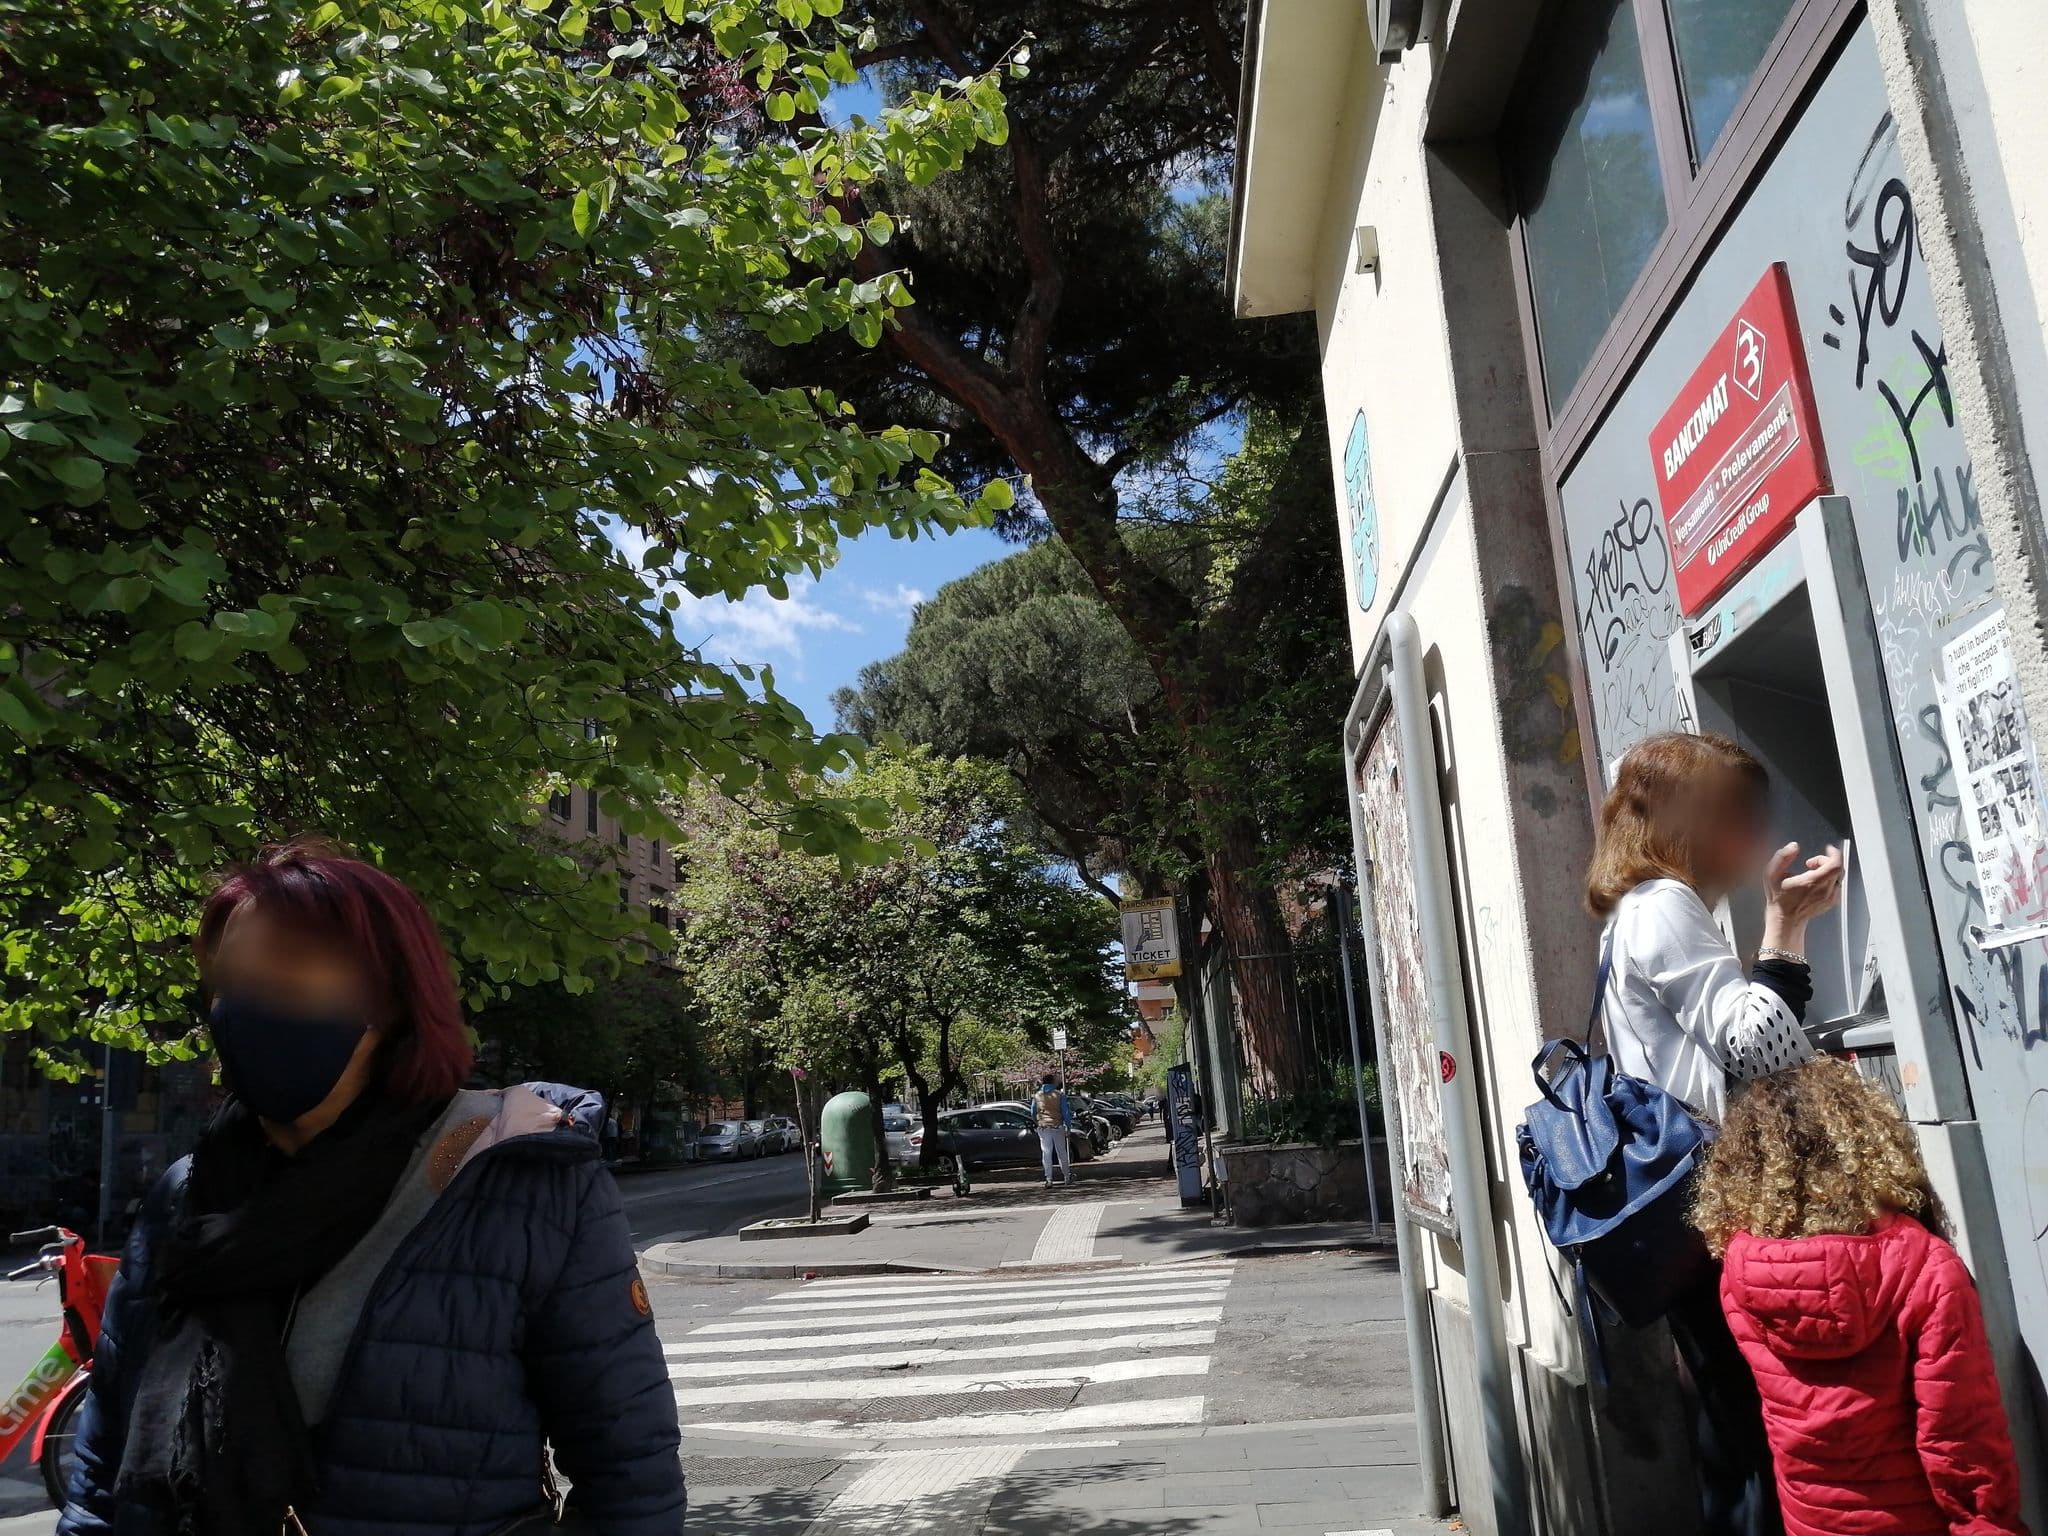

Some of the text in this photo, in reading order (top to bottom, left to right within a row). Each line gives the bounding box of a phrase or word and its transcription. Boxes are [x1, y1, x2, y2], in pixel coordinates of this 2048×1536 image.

[1663, 372, 1729, 481] BANCOMAT
[1675, 484, 1715, 543] Versamenti
[1721, 404, 1788, 487] Prelevamenti
[1715, 515, 1747, 558] UniCredit
[1746, 493, 1770, 525] Group
[1975, 625, 1997, 646] buona
[1958, 660, 1970, 675] che
[1132, 950, 1171, 961] TICKET
